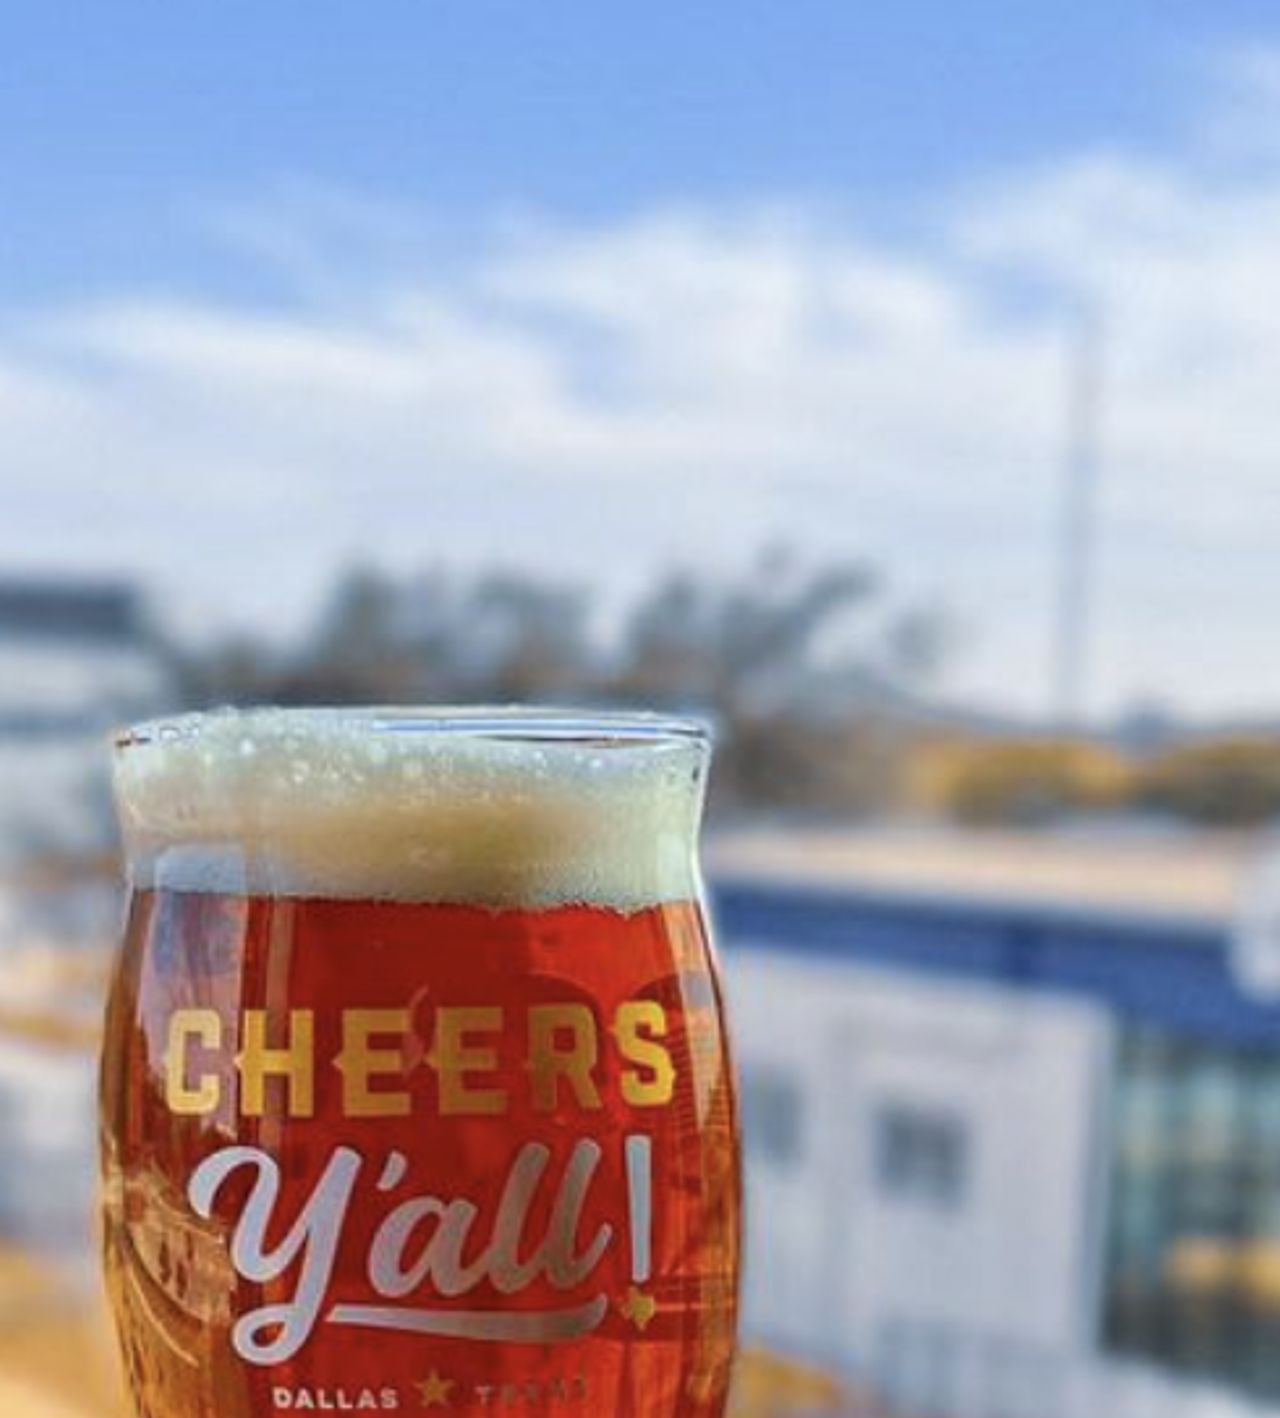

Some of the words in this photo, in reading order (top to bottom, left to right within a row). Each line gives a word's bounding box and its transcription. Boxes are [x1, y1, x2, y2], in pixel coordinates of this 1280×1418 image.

[166, 1001, 676, 1116] CHEERS
[188, 1134, 655, 1365] Y'all!
[272, 1386, 398, 1409] DALLAS
